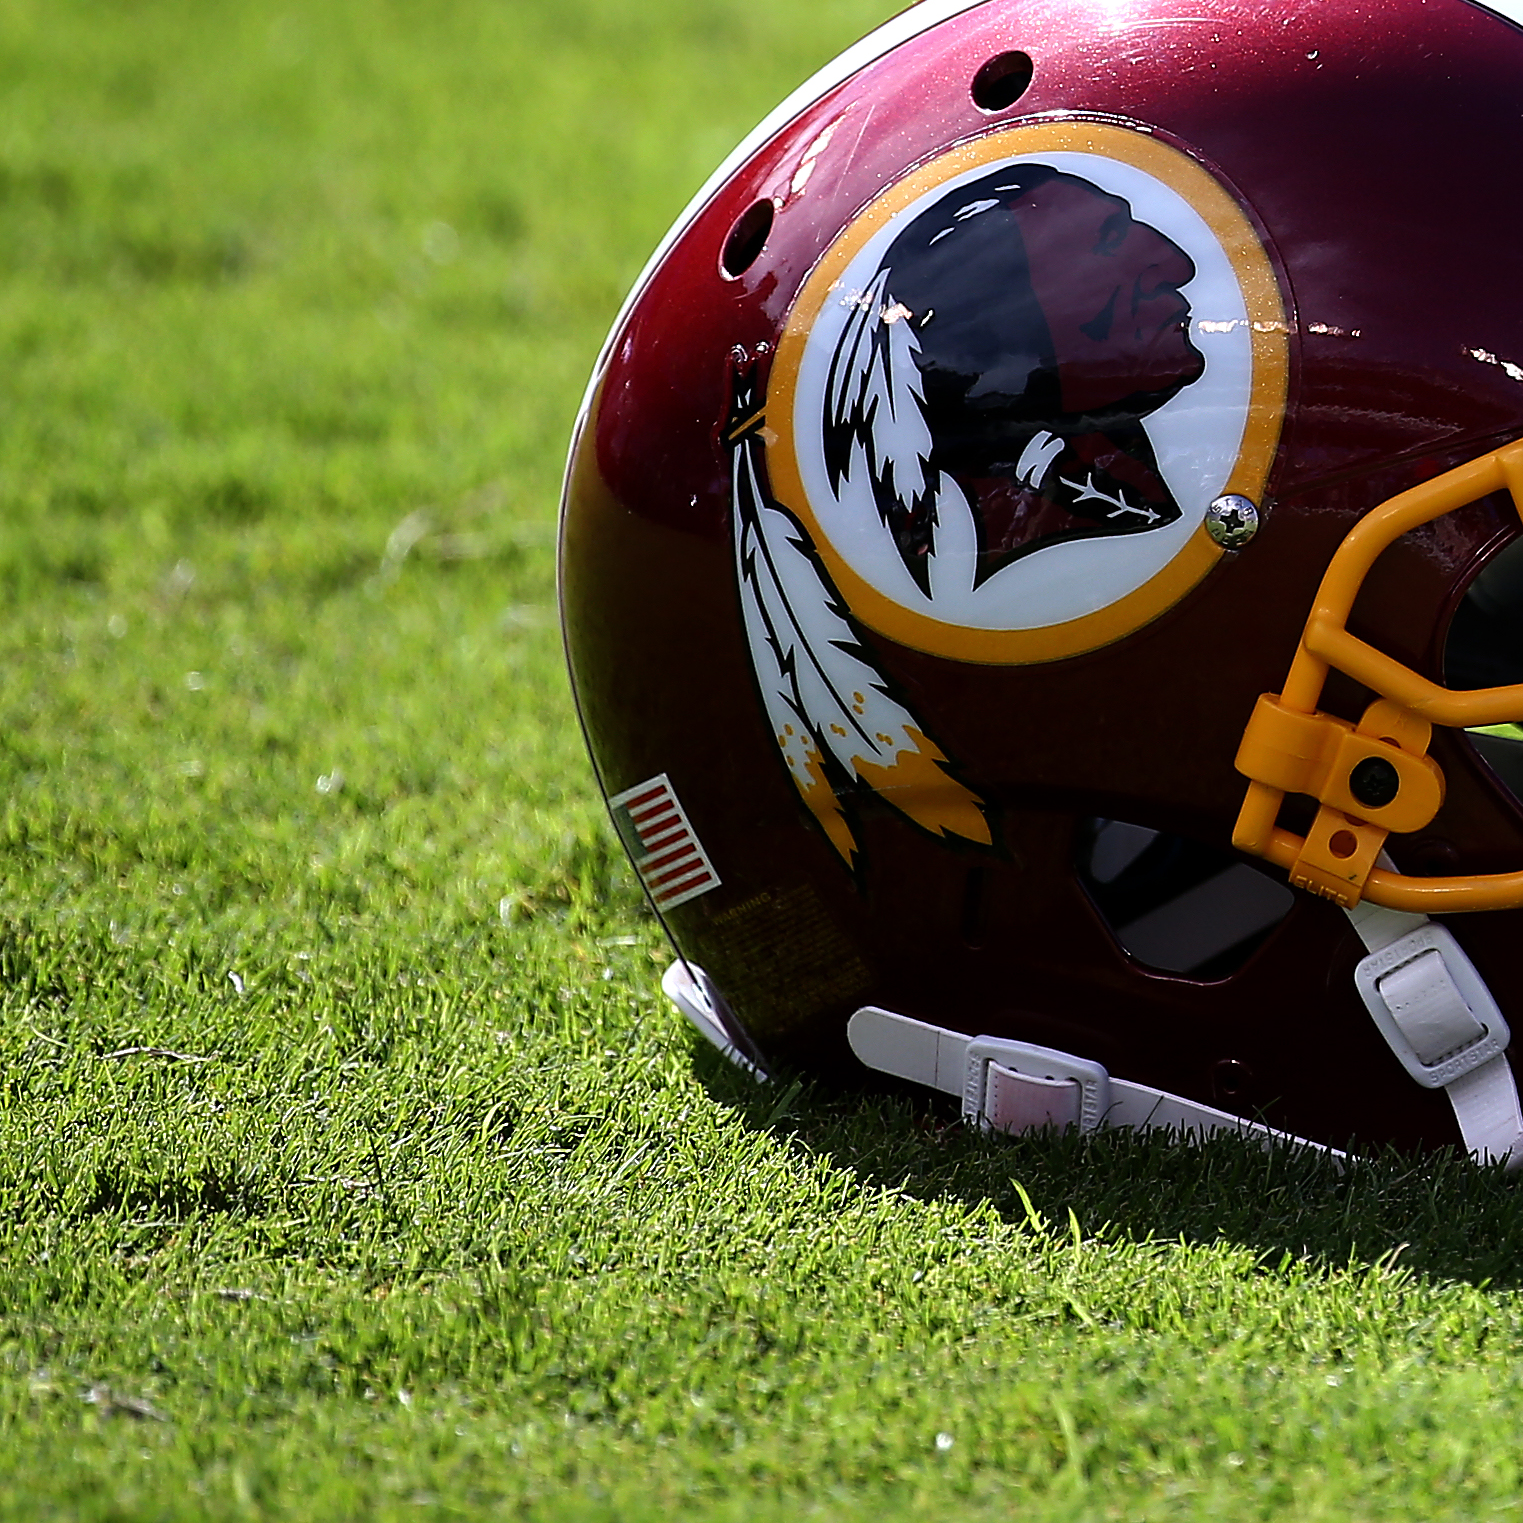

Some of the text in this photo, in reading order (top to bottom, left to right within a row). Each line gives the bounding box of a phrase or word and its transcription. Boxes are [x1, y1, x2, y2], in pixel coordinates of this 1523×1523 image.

[1293, 874, 1348, 907] ELITE
[711, 891, 772, 927] WARNING
[1429, 1037, 1500, 1084] SPORTSTAR
